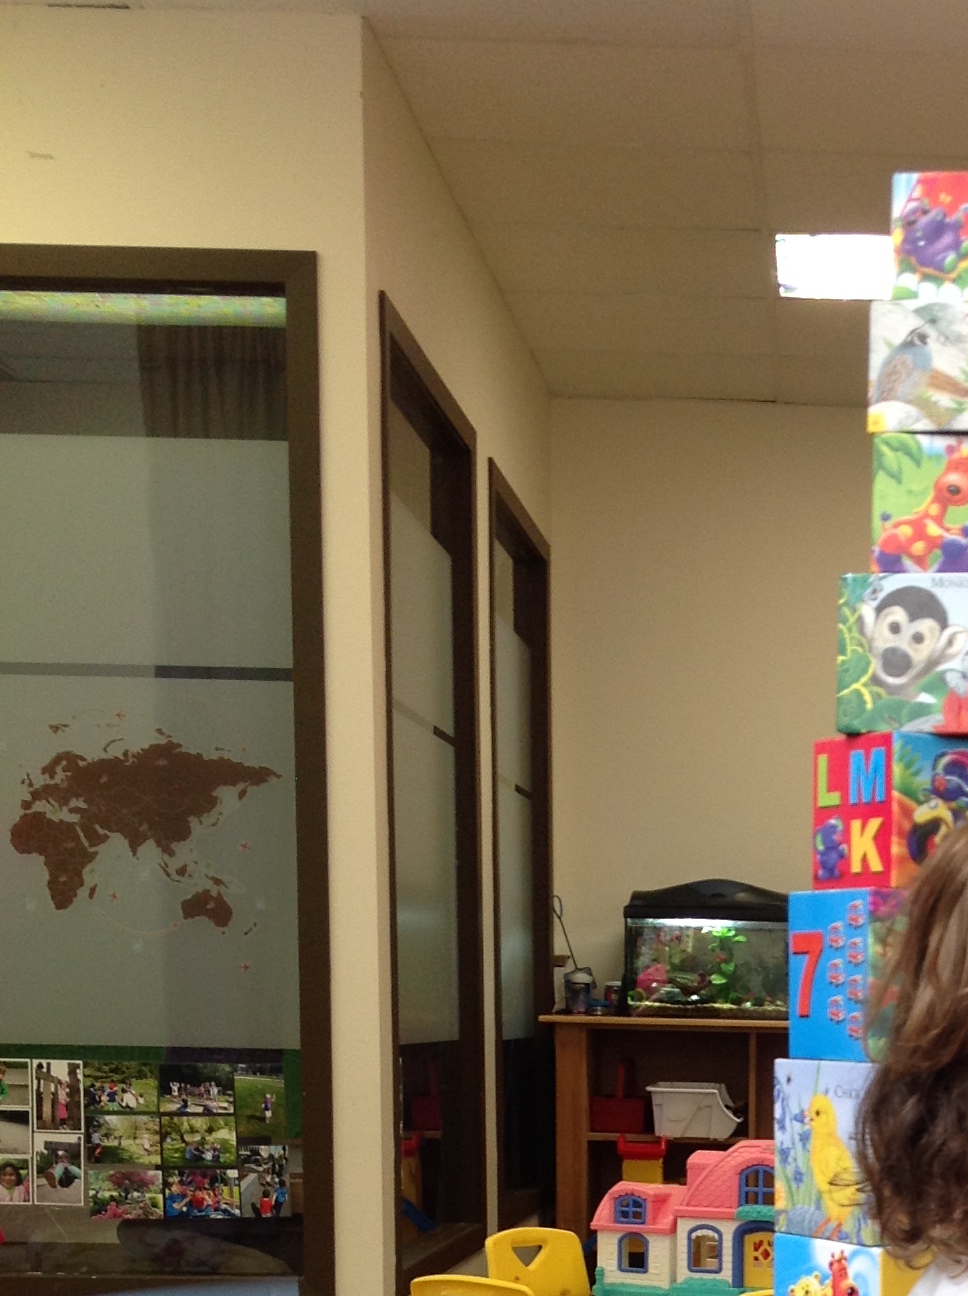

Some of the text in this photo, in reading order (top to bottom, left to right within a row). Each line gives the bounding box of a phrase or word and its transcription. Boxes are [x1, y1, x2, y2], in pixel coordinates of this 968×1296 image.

[817, 747, 886, 808] L M
[849, 817, 884, 874] K
[790, 931, 824, 1018] 7
